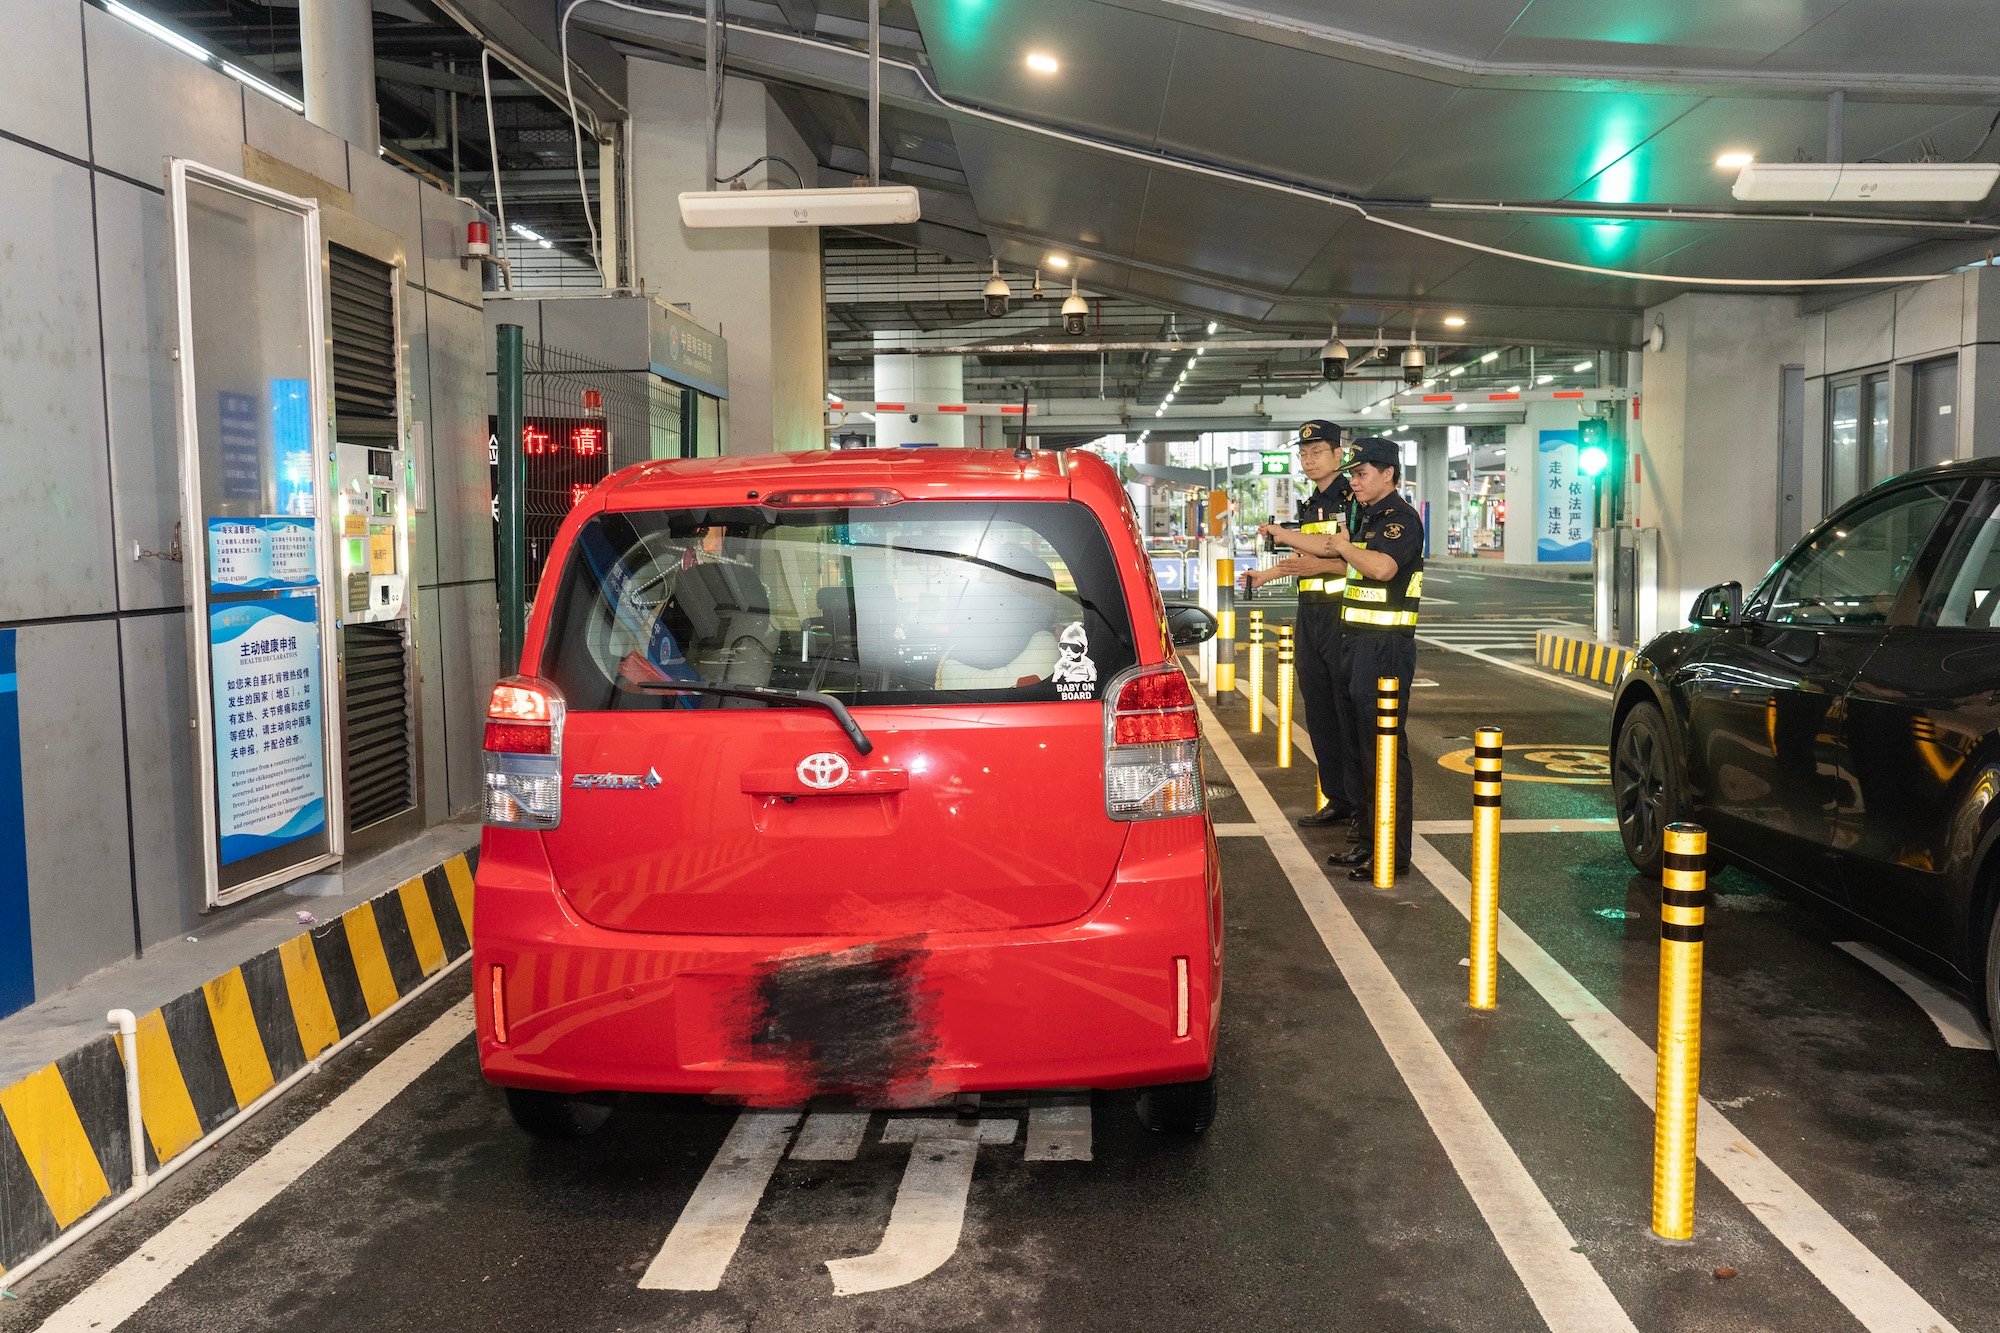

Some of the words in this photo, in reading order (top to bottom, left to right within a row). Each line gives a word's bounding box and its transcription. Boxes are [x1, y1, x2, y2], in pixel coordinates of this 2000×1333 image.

[1568, 482, 1582, 541] 依法严惩
[221, 525, 256, 534] 海关温馨提示
[240, 636, 297, 657] 主动健康申报
[240, 656, 262, 666] HEALTH
[263, 651, 298, 662] DECLARATION
[227, 667, 310, 691] 如您来自基孔肯雅热疫情
[1056, 683, 1081, 692] BABY
[1082, 683, 1095, 692] ON
[1061, 692, 1092, 700] BOARD
[228, 699, 311, 725] 有发热、关节疼痛和皮疹
[229, 715, 312, 742] 等症状，请主动向中国海
[232, 779, 247, 787] where
[284, 766, 295, 774] fever
[295, 762, 313, 771] outbreak
[275, 776, 296, 787] symptoms
[296, 773, 305, 781] such
[233, 806, 260, 820] proactively
[260, 803, 276, 811] declare
[282, 796, 298, 805] Chinese
[298, 791, 315, 800] customs
[247, 797, 259, 806] joint
[290, 785, 304, 793] please
[243, 816, 266, 827] cooperate
